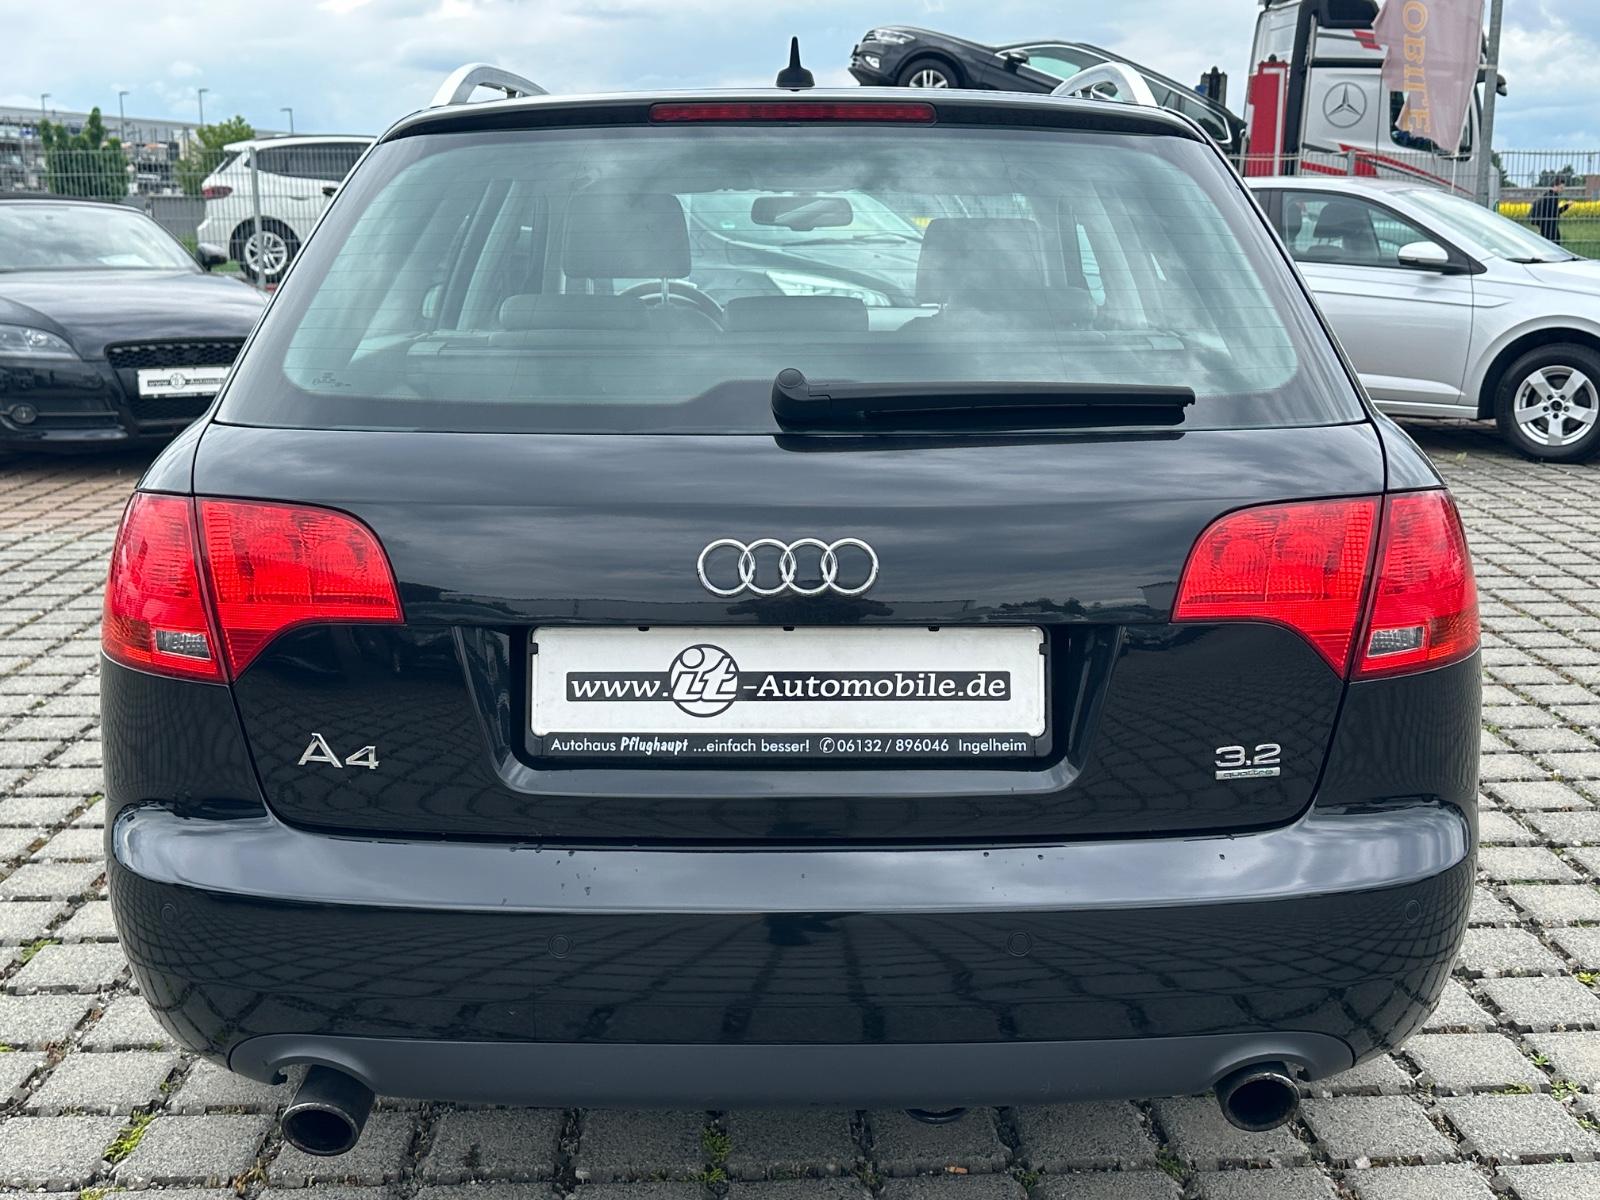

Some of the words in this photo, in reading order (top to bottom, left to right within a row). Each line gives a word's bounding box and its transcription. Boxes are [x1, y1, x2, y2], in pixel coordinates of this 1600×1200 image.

[551, 738, 617, 752] Autohaus
[620, 736, 688, 756] Pflughaupt
[693, 738, 756, 752] ...einfach
[761, 738, 810, 752] besser!
[895, 739, 949, 752] 896046
[958, 738, 1027, 755] Ingelheim
[1215, 743, 1281, 767] 3.2
[1223, 769, 1274, 779] quattro
